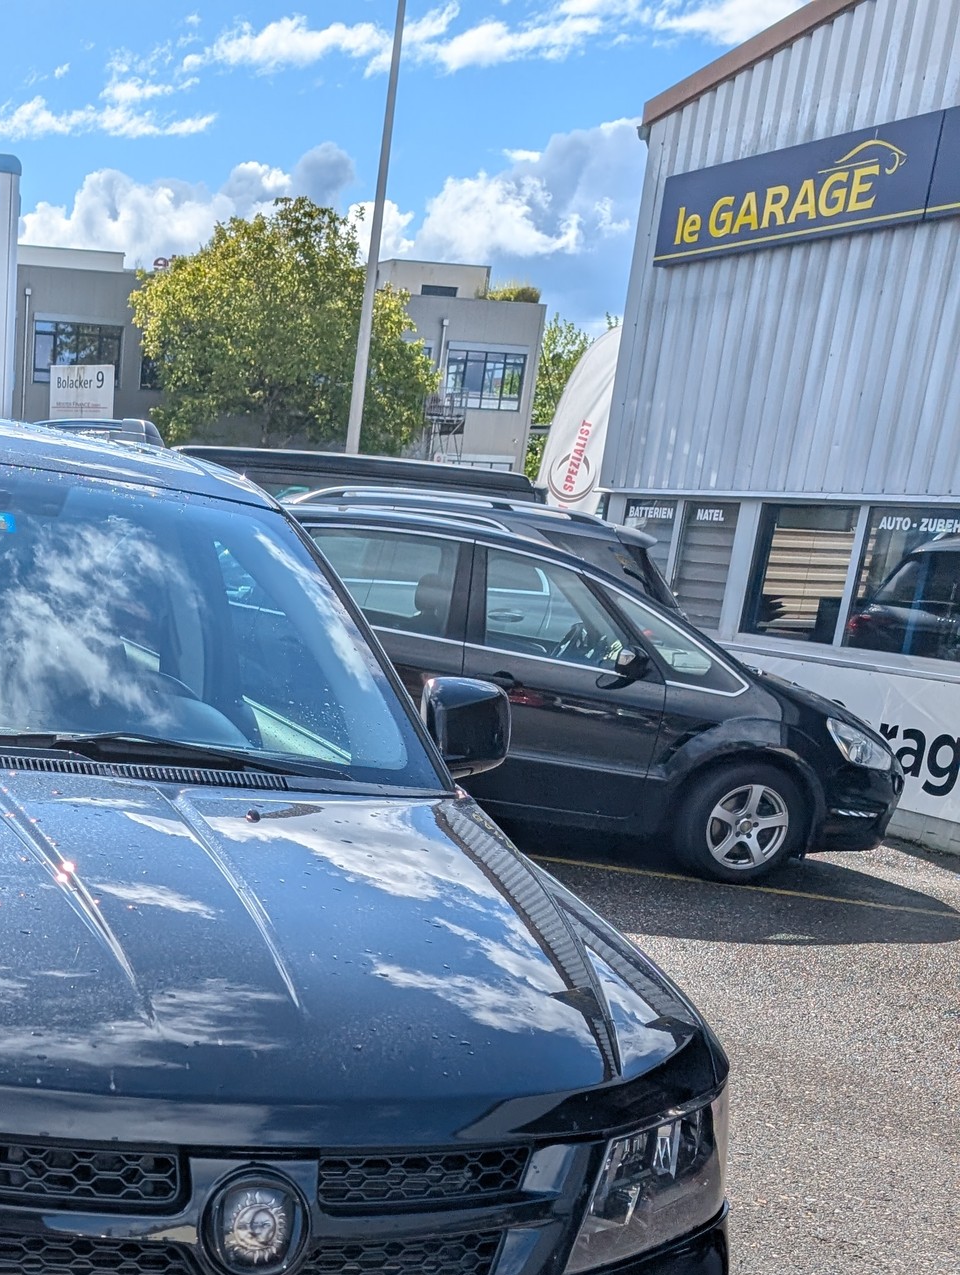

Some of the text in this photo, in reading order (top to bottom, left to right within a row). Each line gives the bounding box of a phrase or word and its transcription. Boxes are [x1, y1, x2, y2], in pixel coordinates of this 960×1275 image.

[673, 164, 881, 245] le GARAGE
[57, 371, 105, 389] Bolacker 9
[563, 419, 592, 492] SPEZIALIST
[628, 506, 674, 519] BATTERIEN
[696, 508, 725, 521] NATEL
